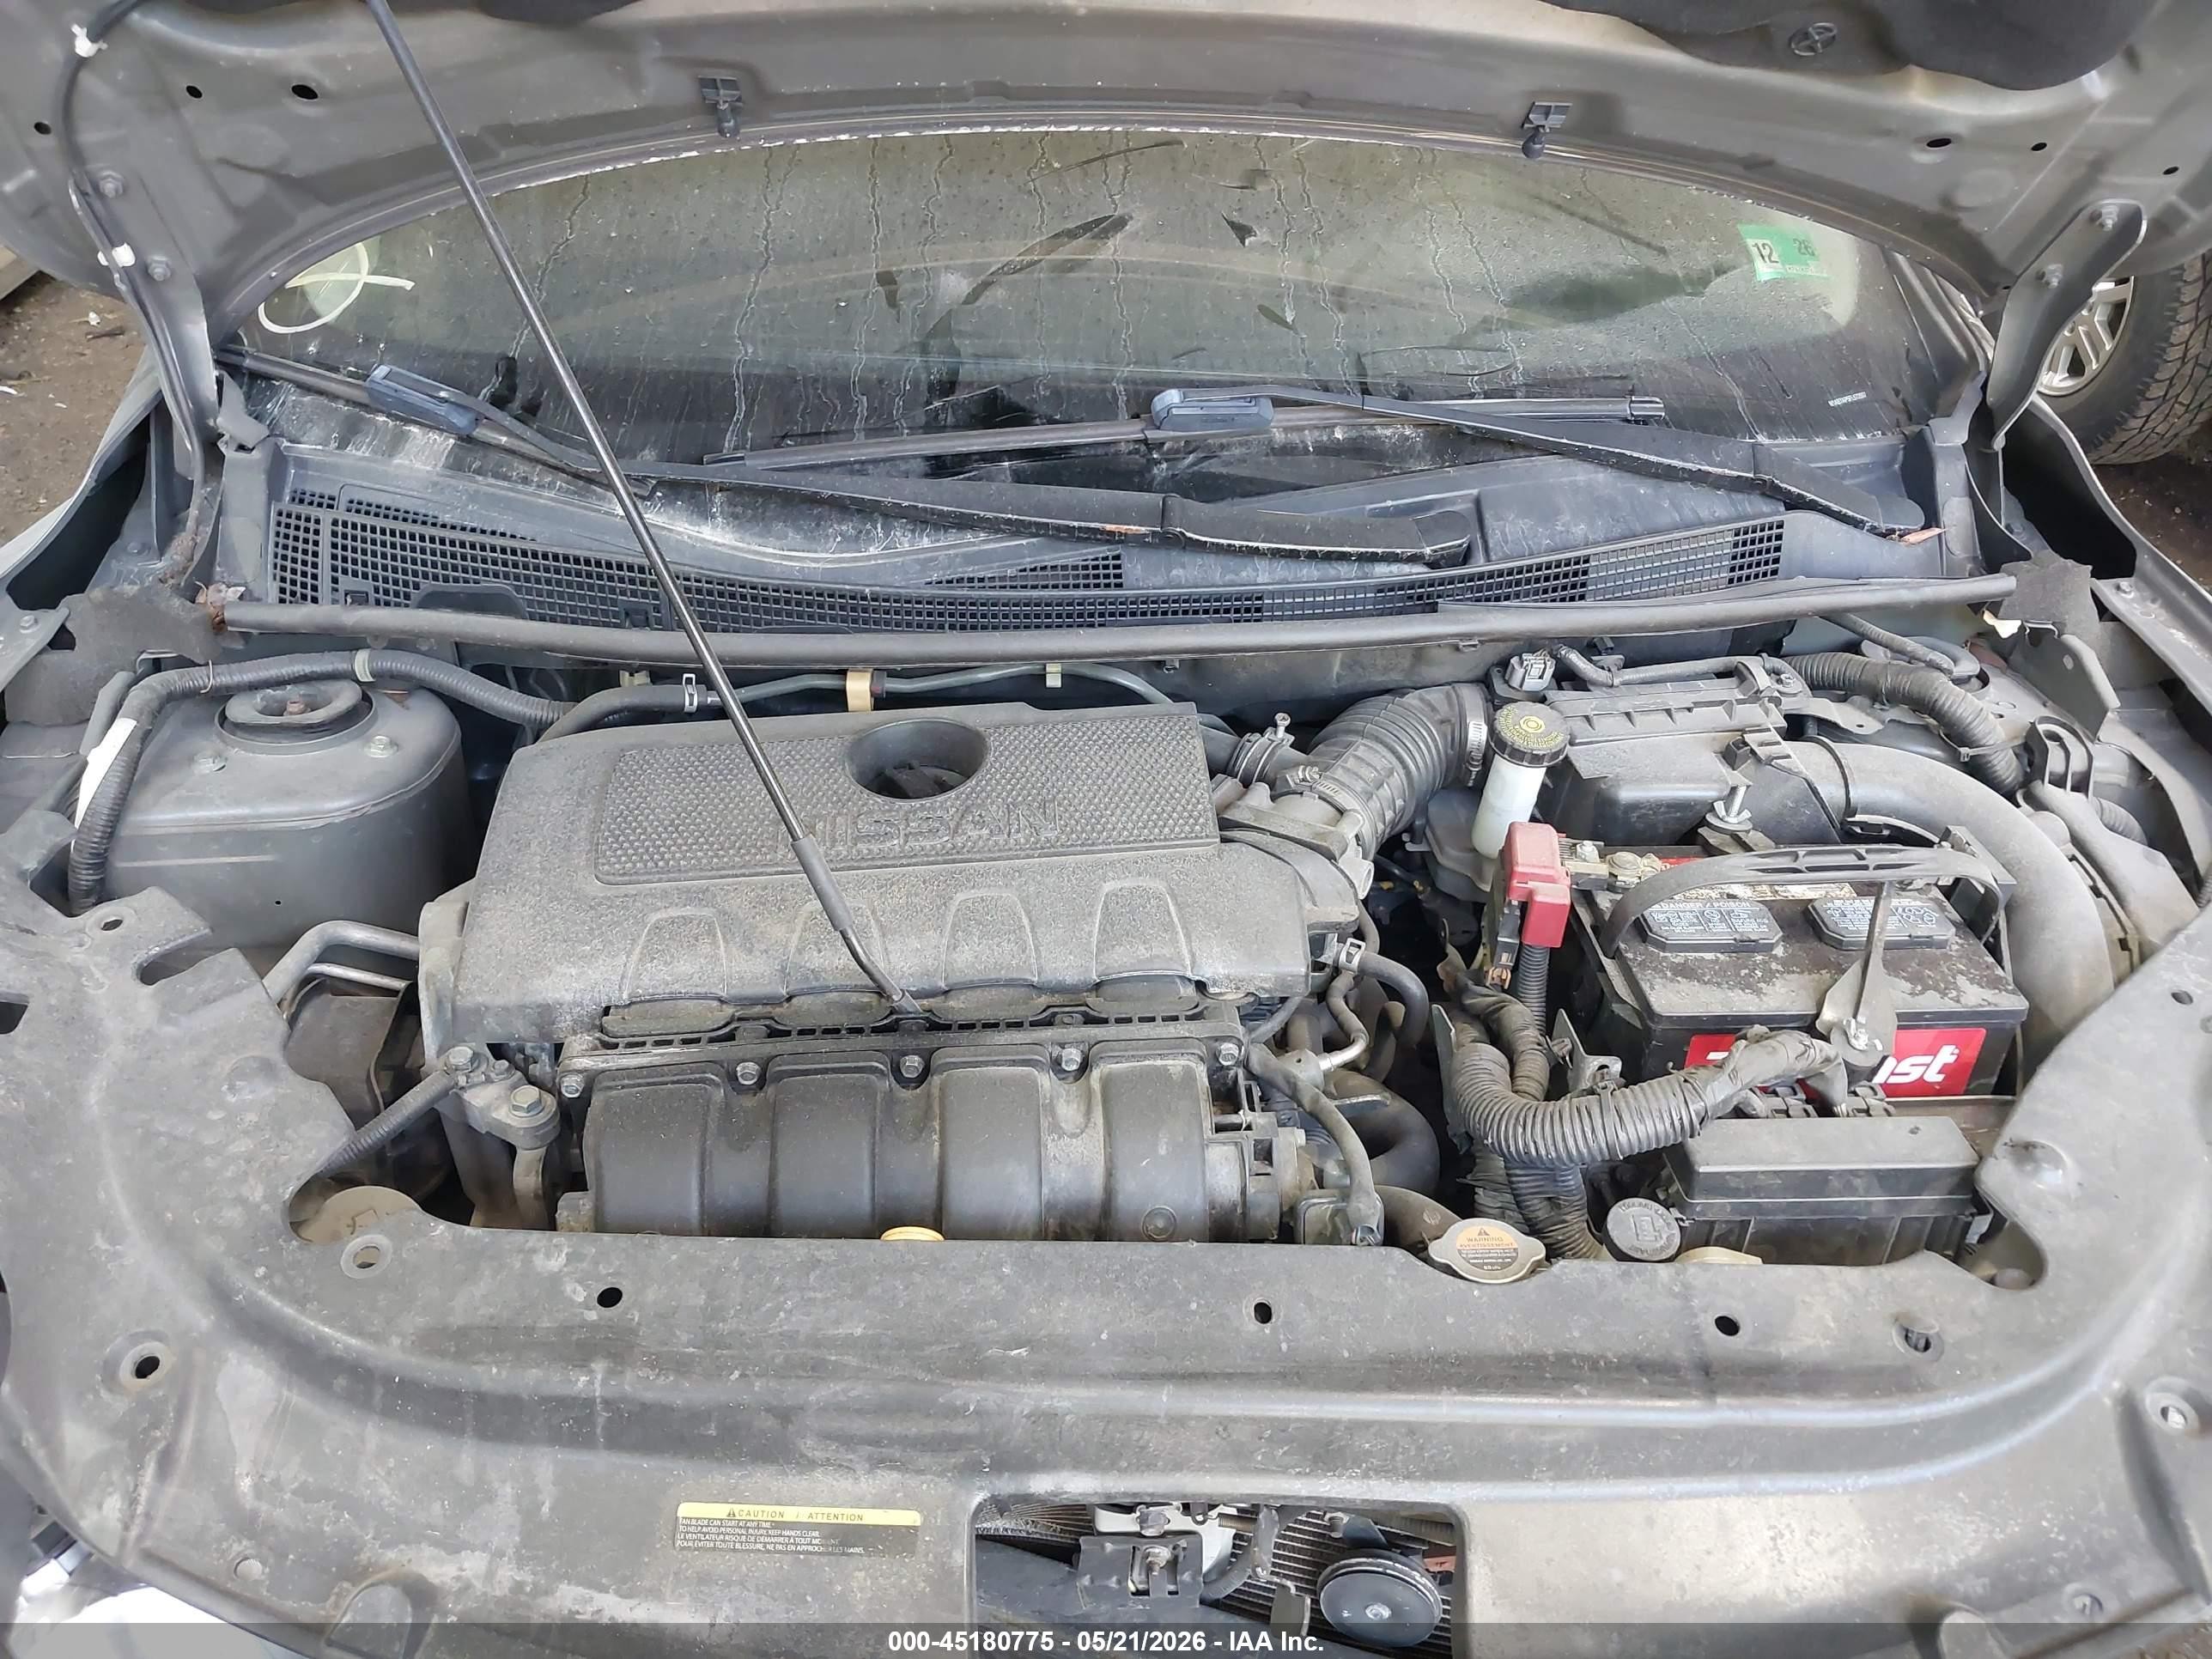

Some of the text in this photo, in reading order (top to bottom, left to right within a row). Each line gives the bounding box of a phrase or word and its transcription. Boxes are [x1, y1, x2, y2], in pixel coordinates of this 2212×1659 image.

[1752, 242, 1779, 264] 12
[738, 1510, 785, 1519] CAUTION
[807, 1512, 864, 1522] ATTENTION
[725, 1534, 746, 1542] RISQUE
